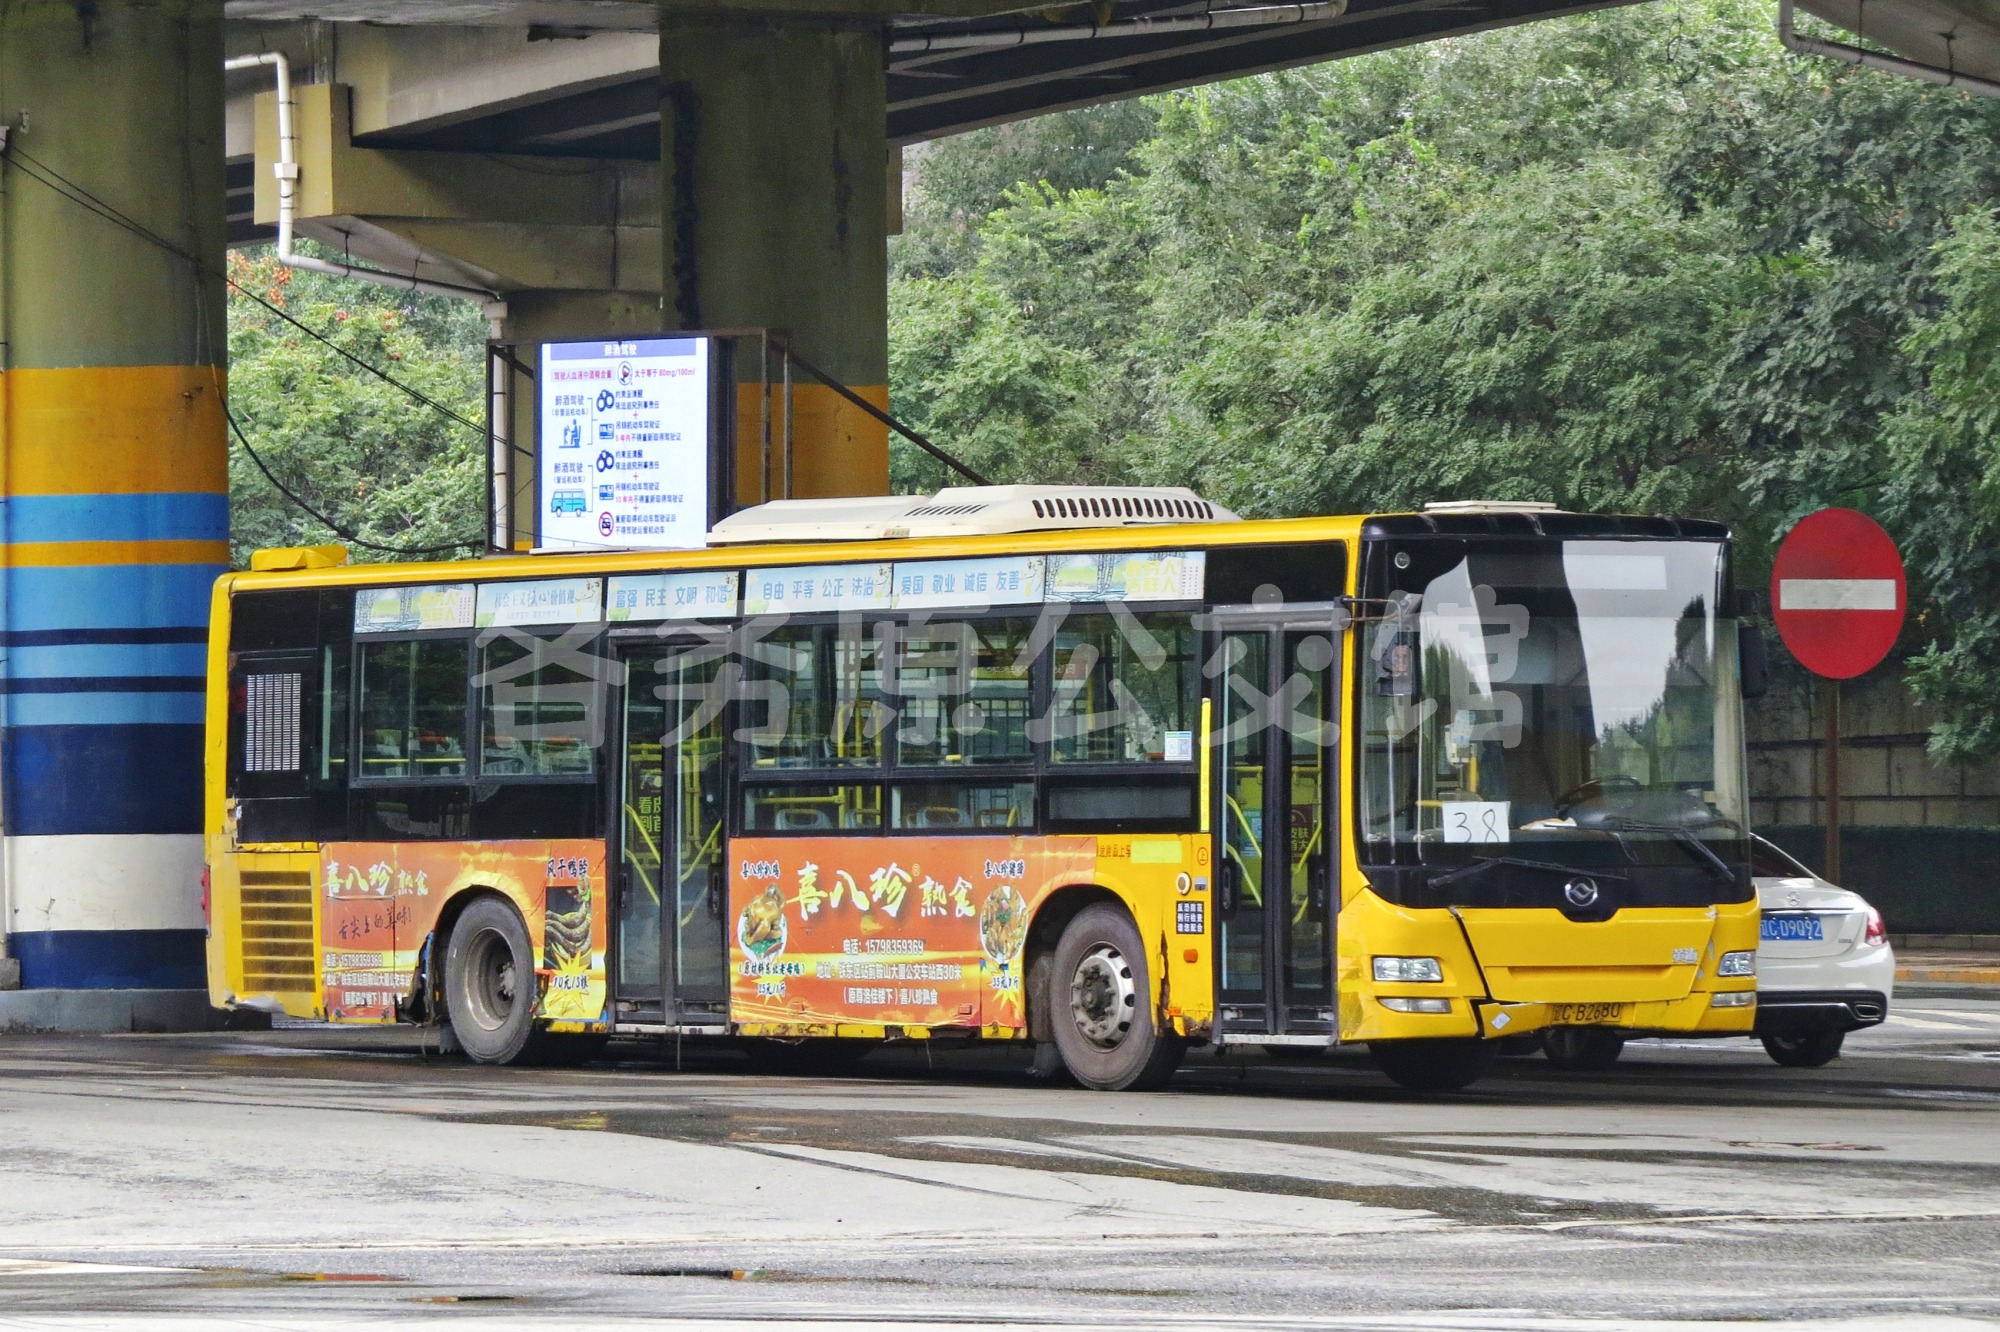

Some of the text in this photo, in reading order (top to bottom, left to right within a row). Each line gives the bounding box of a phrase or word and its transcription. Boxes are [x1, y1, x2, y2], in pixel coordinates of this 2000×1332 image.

[604, 343, 637, 357] 醉酒驾驶
[634, 369, 658, 378] 大于等于
[555, 395, 584, 406] 醉酒驾驶
[615, 420, 660, 430] 吊销机动车驾驶证
[554, 462, 583, 473] 醉酒驾驶
[615, 482, 660, 491] 吊销机动车驾驶证
[763, 576, 875, 600] 自由 平等 公正 法治
[901, 569, 1020, 595] 爱国 敬业 诚信 友善
[494, 586, 576, 609] 社会主义核心价值观
[616, 584, 728, 608] 富强 民主 文明 和谐
[1454, 809, 1500, 843] 38
[321, 860, 394, 897] 喜八珍
[918, 875, 977, 918] 熟食
